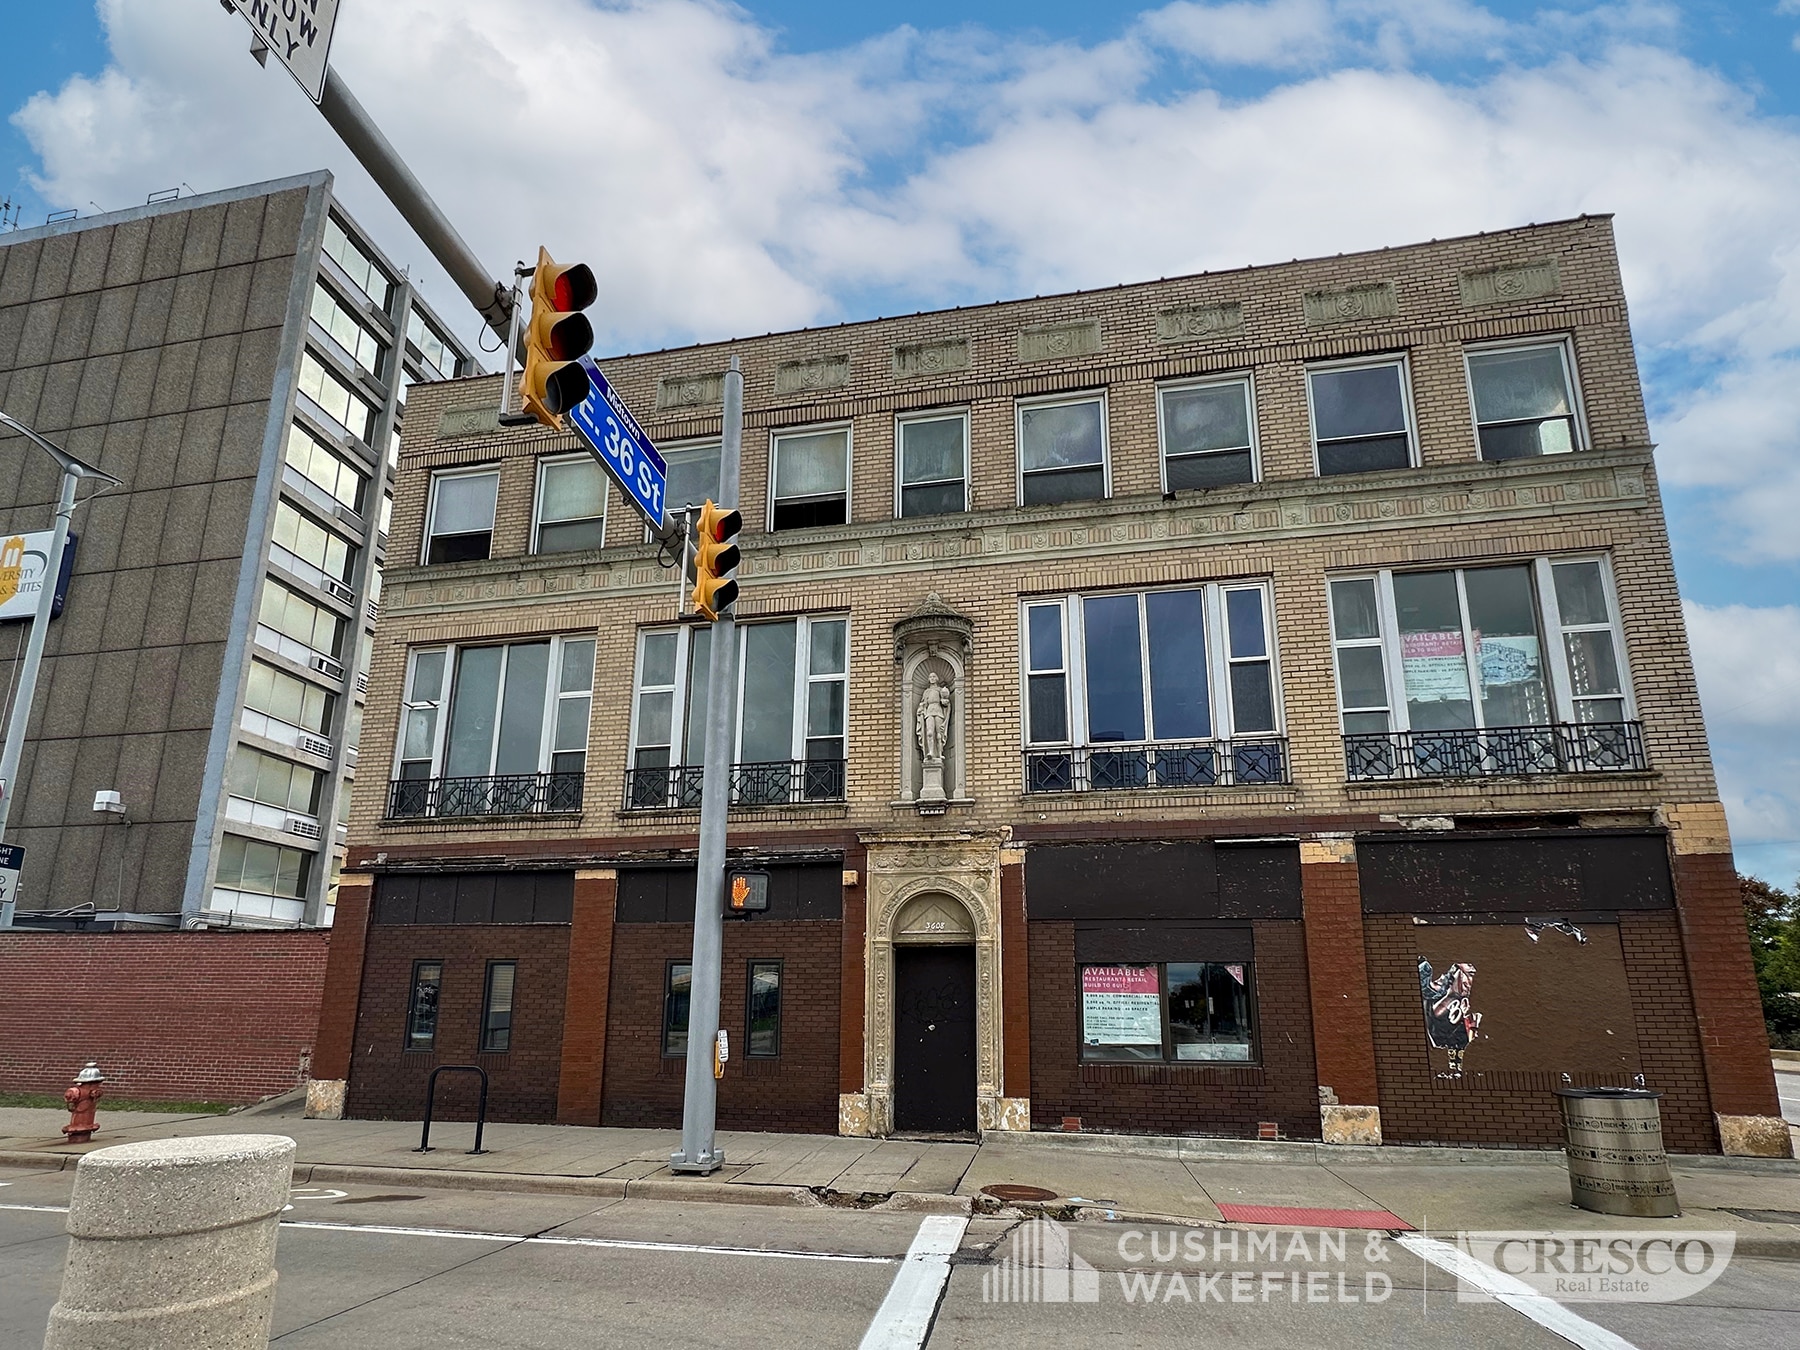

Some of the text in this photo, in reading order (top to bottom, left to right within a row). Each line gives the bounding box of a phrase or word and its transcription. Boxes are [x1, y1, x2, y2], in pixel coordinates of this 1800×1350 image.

[240, 0, 300, 60] NLY
[606, 386, 641, 441] Midtown
[604, 416, 635, 476] 36
[637, 461, 661, 514] St
[0, 568, 36, 581] ERSITY
[10, 580, 42, 594] SUITES
[925, 921, 946, 930] 3608
[1084, 968, 1145, 976] AVAILABLE
